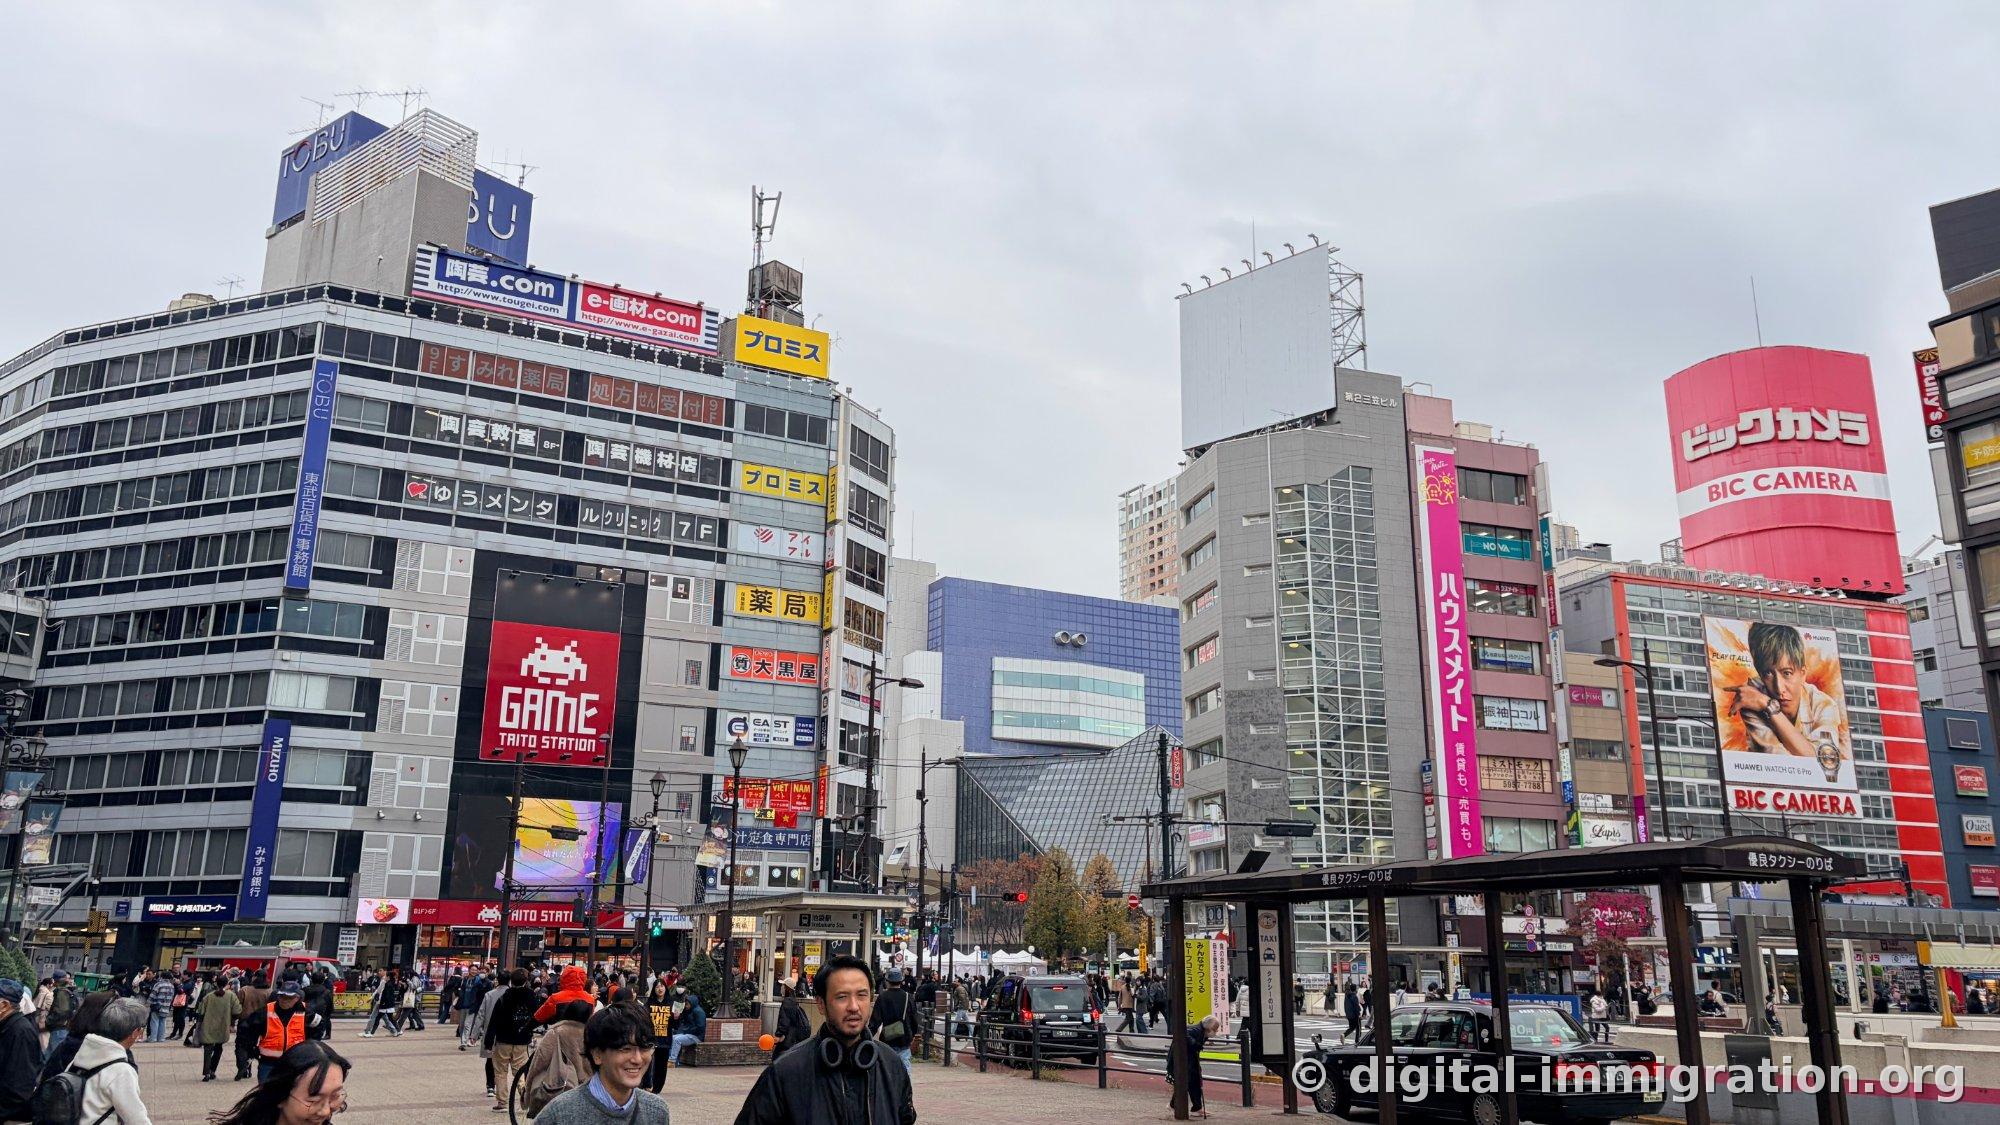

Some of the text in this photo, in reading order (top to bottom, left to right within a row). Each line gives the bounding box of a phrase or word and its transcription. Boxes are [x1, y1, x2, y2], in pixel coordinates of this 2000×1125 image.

[282, 119, 346, 178] TOBU
[445, 258, 556, 299] 陶芸.com
[436, 281, 560, 315] http://www.tougei.com
[587, 293, 697, 329] e-画材.com
[581, 311, 700, 343] http://www.e-gazai.com
[744, 329, 821, 363] プロミス
[449, 354, 566, 392] すみれ薬局
[313, 370, 335, 420] TOBU
[591, 380, 702, 419] 処方せん受付
[1344, 391, 1398, 408] 第2三笠ビル
[439, 414, 537, 448] 陶芸教室
[1681, 406, 1870, 463] ビックカメラ
[586, 439, 700, 474] 陶芸機材店
[745, 470, 822, 496] プロミス
[1707, 471, 1858, 503] BIC CAMERA
[297, 472, 320, 537] 東武百貨店
[1483, 541, 1511, 553] NOVA
[1542, 530, 1550, 558] NOVA
[749, 587, 807, 618] 薬局
[1438, 572, 1468, 732] ハウスメイト
[1812, 634, 1833, 642] HUAWEI
[734, 656, 818, 680] 質 大黒屋
[1712, 652, 1728, 660] PLAY
[499, 685, 600, 736] GAME
[499, 732, 596, 752] TAITO STATION
[267, 736, 284, 783] MIZUHO
[1734, 763, 1764, 772] HUAWEI
[1764, 764, 1787, 773] WATCH
[793, 783, 812, 794] NAM
[1734, 788, 1858, 816] BIC CAMERA
[728, 830, 812, 847] 汁定食専門店
[1637, 815, 1647, 843] Rakute
[250, 846, 266, 898] みずほ銀行
[148, 903, 174, 912] MIZUHO
[510, 909, 538, 922] AITO
[540, 910, 574, 922] STATI
[1260, 934, 1278, 943] TAXI
[1266, 970, 1275, 1019] タクシーのりば
